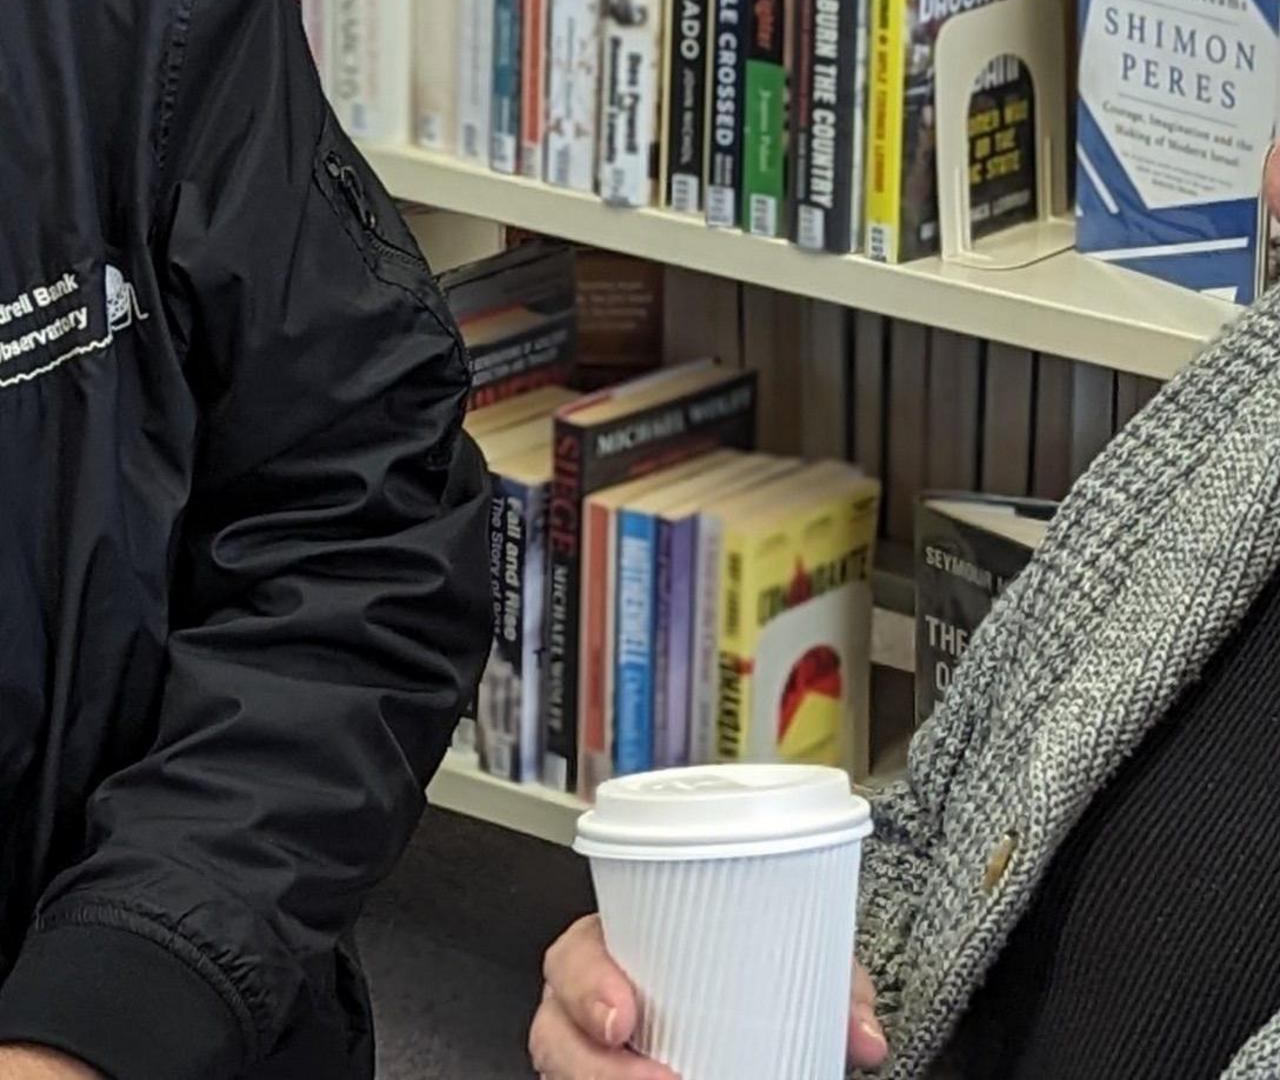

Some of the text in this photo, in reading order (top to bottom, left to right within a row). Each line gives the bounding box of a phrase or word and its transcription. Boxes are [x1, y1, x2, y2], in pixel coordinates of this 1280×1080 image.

[1104, 6, 1256, 71] SHIMON
[681, 68, 696, 109] JOHN
[715, 32, 738, 147] CROSSED
[812, 63, 838, 105] THE
[1121, 53, 1237, 110] PERES
[809, 107, 837, 210] COUNTRY
[1115, 124, 1207, 160] Making of Modern
[1149, 113, 1211, 142] Imagination
[1213, 129, 1233, 147] and
[1236, 134, 1254, 152] the
[33, 273, 80, 308] Bank
[594, 408, 685, 456] MICHAEL
[489, 497, 506, 580] The Story
[503, 496, 523, 642] Fall and Rise
[551, 565, 569, 657] MICHAEL
